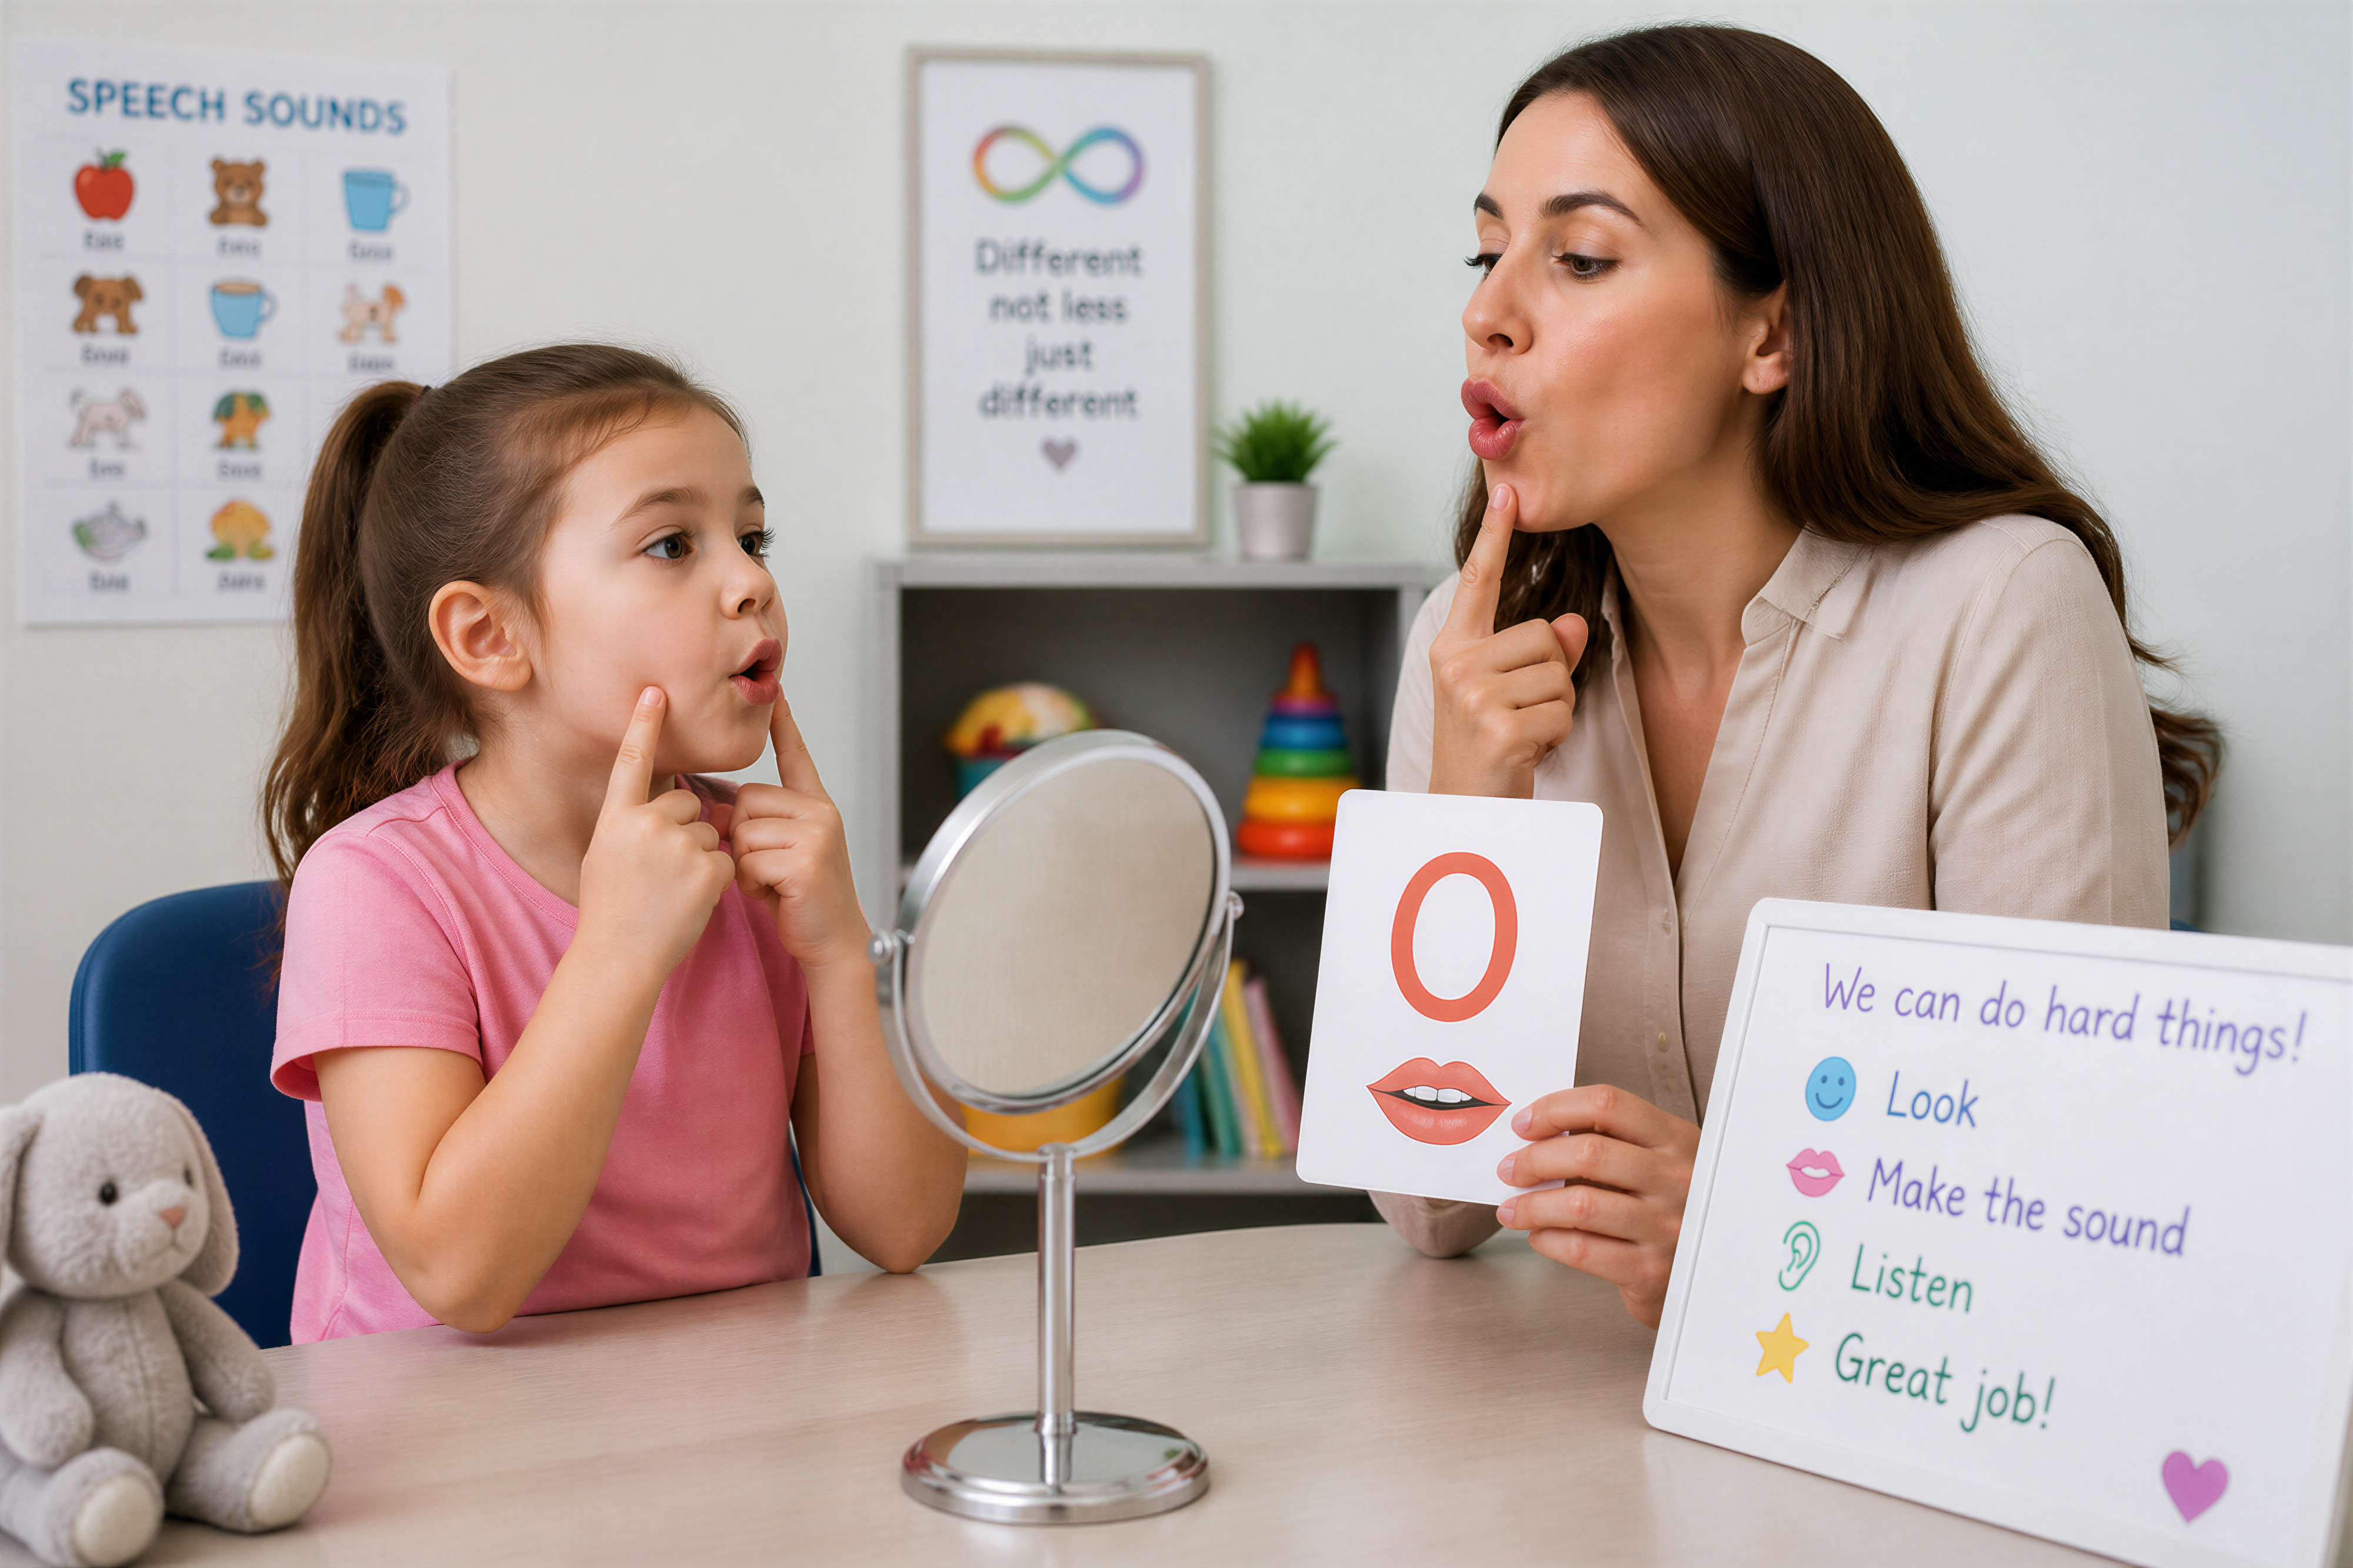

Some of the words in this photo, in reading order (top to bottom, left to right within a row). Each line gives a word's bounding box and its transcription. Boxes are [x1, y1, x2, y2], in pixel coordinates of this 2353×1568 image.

[68, 79, 225, 122] SPEECH
[244, 91, 406, 135] SOUNDS
[976, 239, 1141, 276] Different
[989, 290, 1051, 323] not
[1062, 288, 1128, 323] less
[1024, 335, 1094, 377] just
[978, 382, 1138, 418] different
[1390, 852, 1518, 1023] O
[1825, 963, 1875, 1013] We
[1894, 987, 1960, 1022] can
[1979, 980, 2025, 1029] do
[2044, 985, 2140, 1041] hard
[2157, 999, 2307, 1077] things!
[1887, 1071, 1978, 1127] Look
[1868, 1157, 1965, 1217] Make
[1984, 1177, 2045, 1232] the
[2063, 1205, 2190, 1257] sound
[1851, 1244, 1972, 1312] Listen
[1835, 1332, 1952, 1405] Great
[1960, 1370, 2055, 1433] job!
